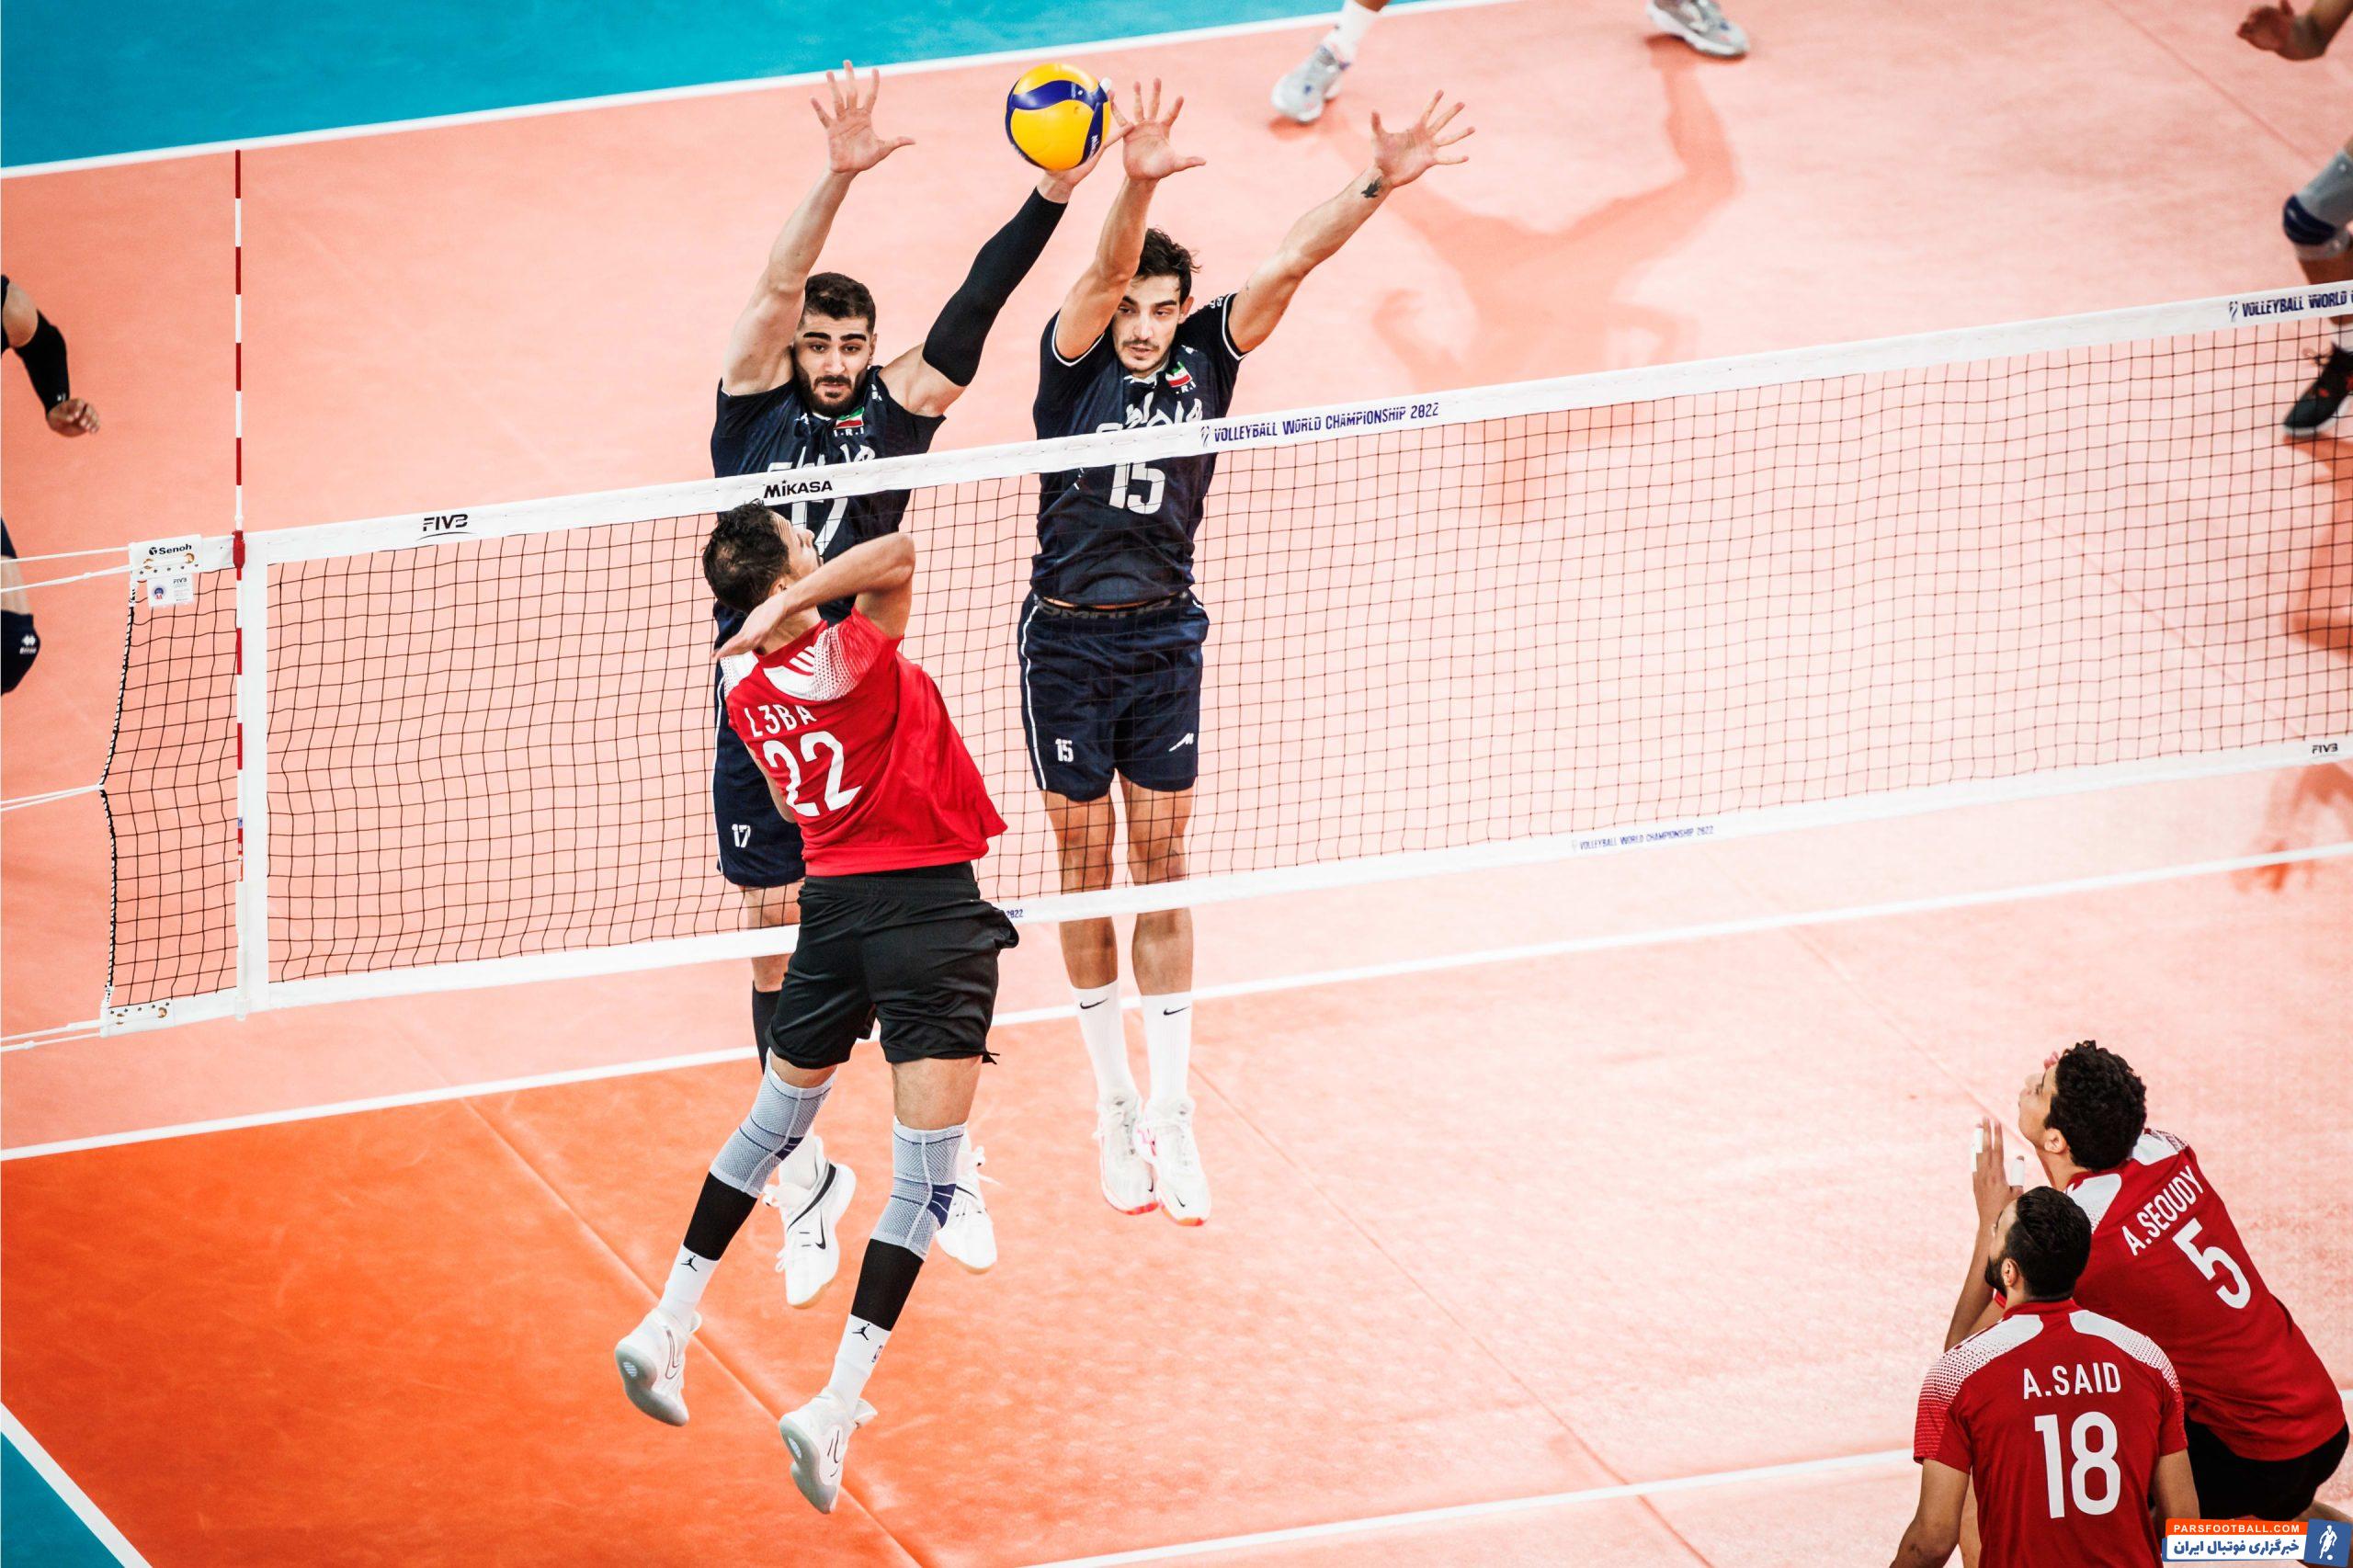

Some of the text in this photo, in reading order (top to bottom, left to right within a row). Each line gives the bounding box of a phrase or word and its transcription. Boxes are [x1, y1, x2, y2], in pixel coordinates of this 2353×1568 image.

[2242, 296, 2304, 317] VOLLEYBALL
[2308, 290, 2347, 309] WORLD
[1214, 402, 1439, 442] VOLLEYBALL WORLD CHAMPIONSHIP 2022
[763, 480, 833, 499] MIKASA
[1108, 460, 1166, 515] 15
[423, 513, 469, 532] FIVB
[159, 543, 192, 555] Senoh
[744, 703, 817, 738] L3BA
[1055, 738, 1074, 763] 15
[2312, 743, 2338, 755] FIVB
[762, 730, 862, 817] 22
[732, 824, 751, 848] 17
[1580, 838, 1618, 850] VOLLEYBALL
[1620, 834, 1643, 846] WORLD
[1646, 827, 1695, 843] CHAMPIONSHIP
[2121, 1165, 2204, 1256] A.SEOUDY
[2172, 1217, 2252, 1310] 5
[2023, 1362, 2121, 1400] A.SAID
[2034, 1411, 2121, 1519] 18
